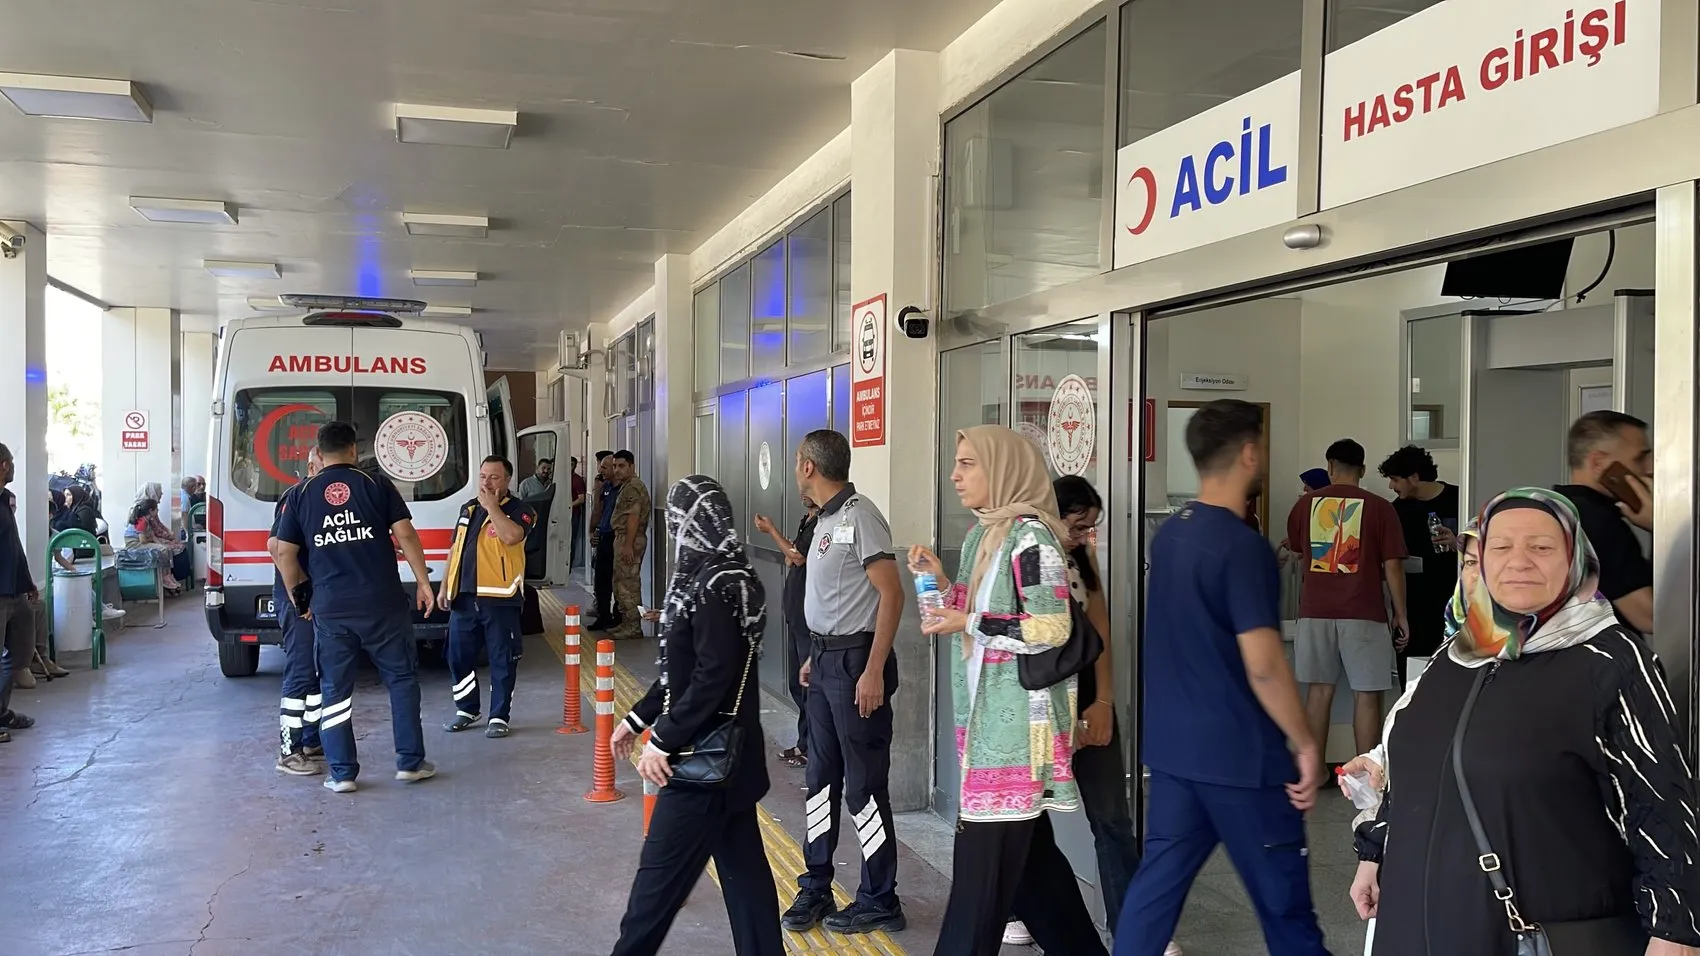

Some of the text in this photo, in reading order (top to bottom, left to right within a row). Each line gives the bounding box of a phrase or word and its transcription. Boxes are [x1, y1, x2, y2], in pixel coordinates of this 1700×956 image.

[1343, 64, 1466, 142] HASTA
[1169, 115, 1288, 219] ACİL
[268, 354, 427, 375] AMBULANS
[856, 386, 881, 403] AMBULANS
[322, 509, 361, 529] ACİL
[313, 527, 375, 547] SAĞLIK
